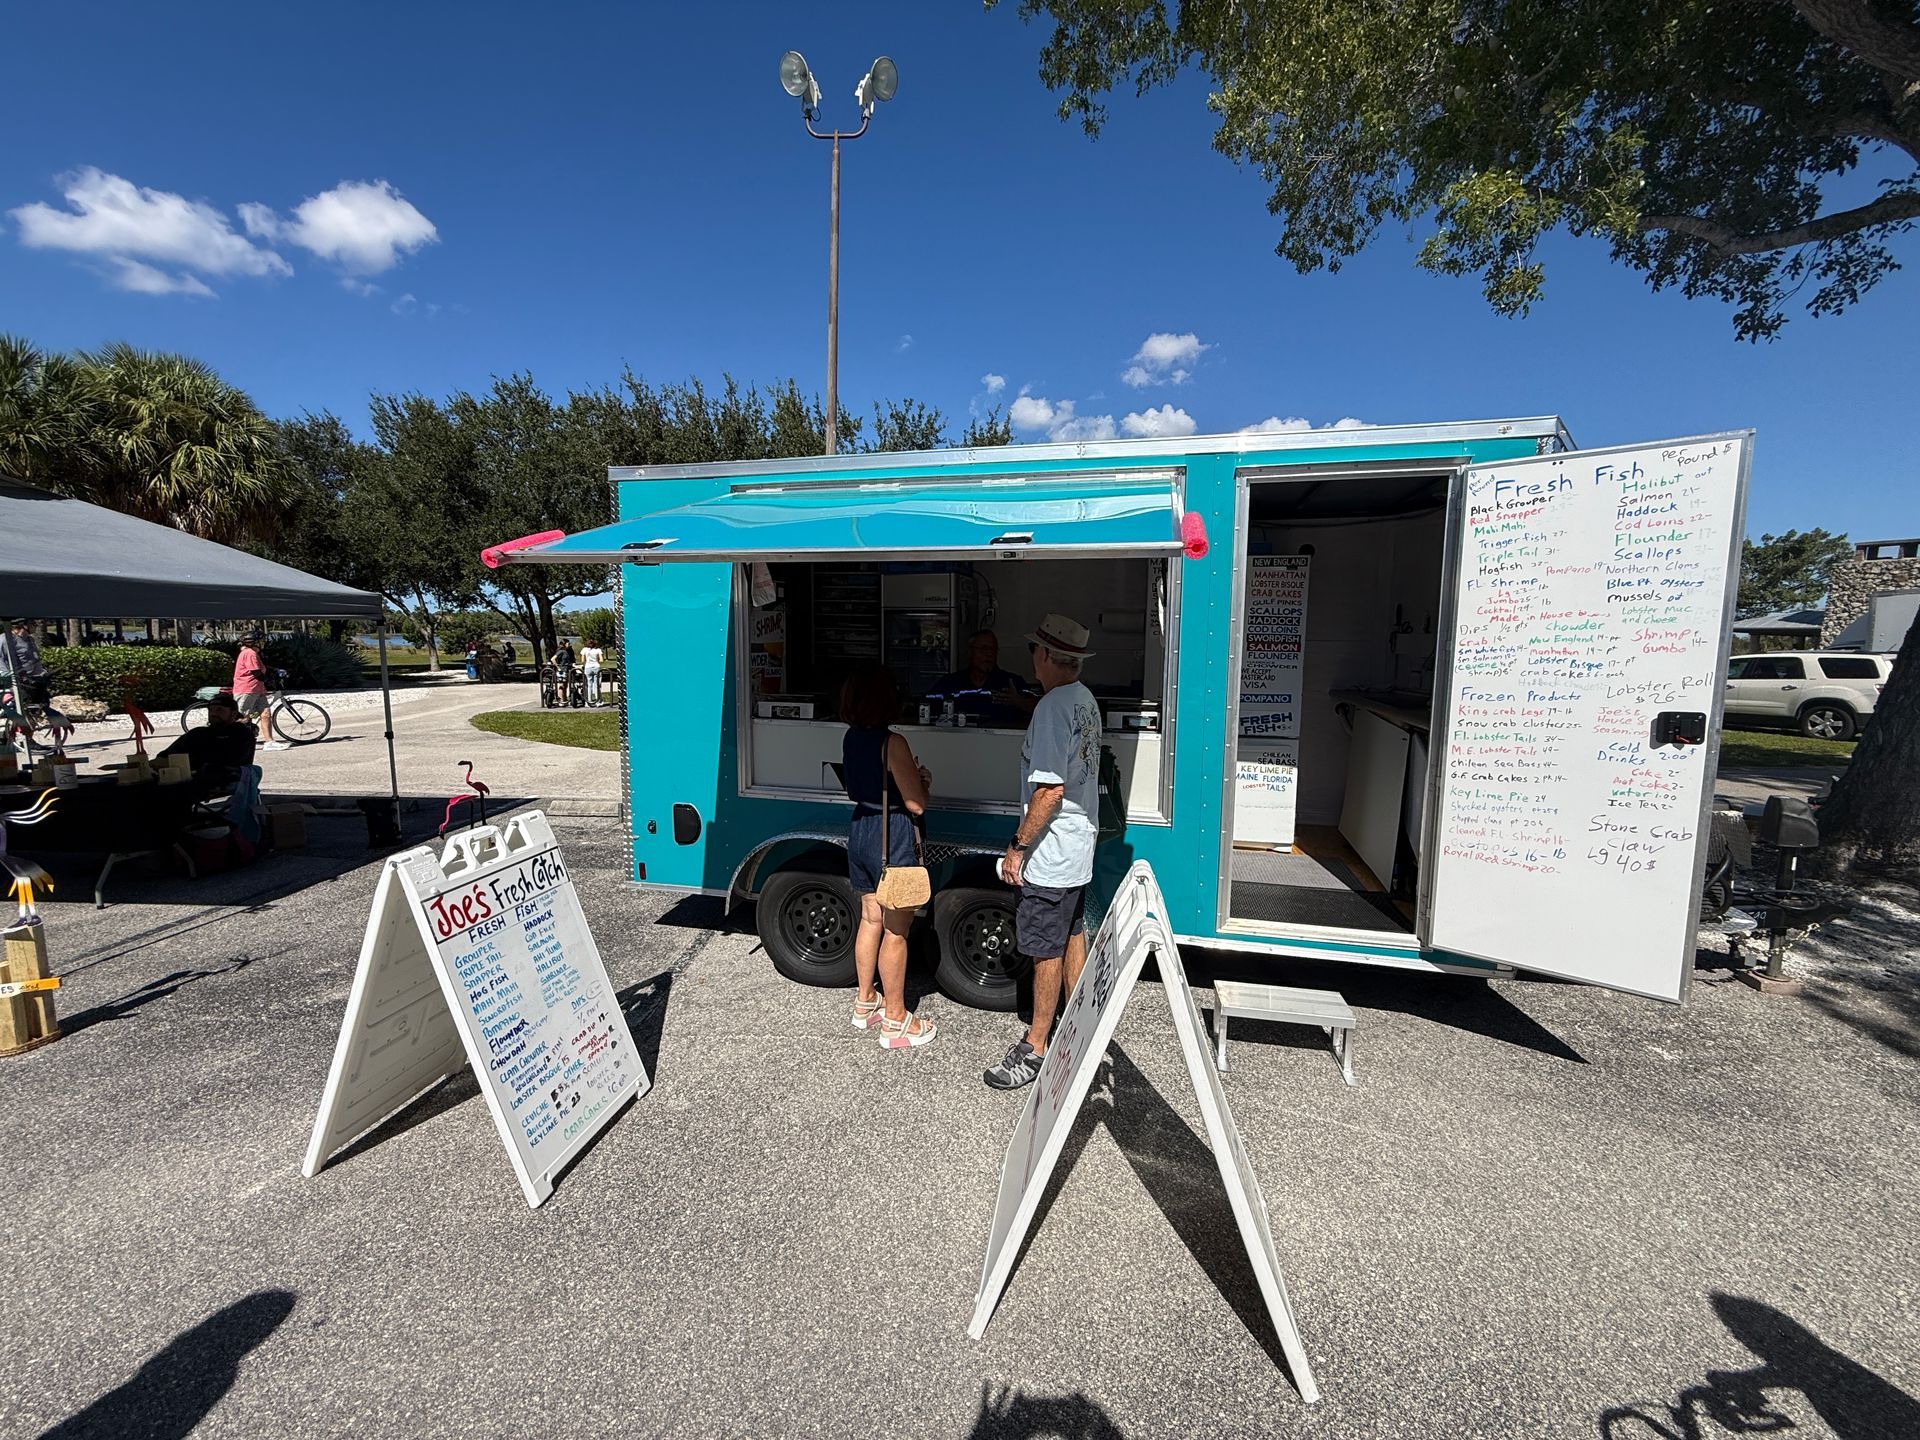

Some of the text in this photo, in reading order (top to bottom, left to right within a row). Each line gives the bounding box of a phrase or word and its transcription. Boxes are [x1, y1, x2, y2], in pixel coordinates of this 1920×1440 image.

[1494, 461, 1643, 500] Fresh Fish
[1622, 473, 1683, 493] Halibut
[1470, 501, 1503, 516] Black
[1505, 495, 1554, 509] Grouper
[1617, 492, 1672, 507] Salmon
[1469, 514, 1489, 526] Red
[1495, 507, 1544, 522] Snapper
[1616, 502, 1677, 519] Haddock
[1614, 519, 1640, 530] Cod
[1615, 529, 1693, 546] Flounder
[1477, 547, 1537, 563] Triple Tail
[1613, 547, 1682, 561] Scallops
[1253, 558, 1307, 567] NEW ENGLAND
[1479, 561, 1522, 576] Hogfish
[1605, 564, 1659, 574] Northern
[1254, 571, 1306, 579] MANHATTAN
[1250, 581, 1305, 590] LOBSTER BISQUE
[1606, 578, 1633, 589] Blue
[1251, 589, 1302, 598] CRAB CAKES
[1606, 589, 1662, 602] mussels
[1486, 596, 1519, 605] Jumbo
[1249, 607, 1303, 616] SCALLOPS
[1488, 610, 1573, 623] Made House
[1621, 605, 1658, 615] Lobster
[1247, 616, 1300, 625] HADDOCK
[1247, 625, 1299, 634] COD LOINS
[1630, 627, 1692, 642] Shrimp
[1247, 634, 1300, 643] SWORDFISH
[1458, 636, 1487, 647] Crab
[1528, 634, 1594, 646] New England
[1248, 643, 1298, 652] SALMON
[1641, 642, 1687, 653] Gumbo
[1247, 652, 1299, 661] FLOUNDER
[1527, 656, 1604, 672] Lobster Bisque
[1251, 667, 1272, 676] ACCEPT
[1243, 681, 1267, 690] VISA
[1605, 679, 1672, 699] Lobster
[1681, 671, 1714, 690] Roll
[1460, 686, 1581, 702] Frozen Products
[1457, 704, 1544, 717] King Legs
[1239, 711, 1293, 726] FRESH
[1243, 723, 1276, 735] FISH
[1592, 724, 1650, 738] Seasoning
[1608, 741, 1641, 753] Cold
[1257, 757, 1296, 766] SEA BASS
[1262, 751, 1291, 759] CHILEAN
[1596, 750, 1647, 765] Drinks
[1240, 765, 1293, 775] KEY LIME PIE
[1493, 759, 1514, 768] Sea
[1262, 775, 1293, 784] FLORIDA
[1496, 773, 1529, 783] Cakes
[1631, 768, 1662, 778] Coke
[1266, 783, 1286, 792] TAILS
[1639, 780, 1672, 791] Coke
[1449, 785, 1529, 802] Key Lime Pie
[1607, 798, 1659, 810] Ice Tea
[1587, 814, 1693, 841] Stone Crab
[1606, 836, 1666, 853] Claw
[1443, 845, 1473, 860] Royal
[1474, 850, 1500, 864] Red
[1501, 857, 1540, 873] Shrimp
[429, 883, 492, 937] Joe's
[488, 867, 534, 909] Fresh
[531, 851, 565, 890] Catch
[523, 909, 554, 932] HADDOCK
[467, 915, 507, 943] FRESH
[527, 933, 555, 952] SALMON
[454, 941, 497, 970] GROUPER
[458, 951, 504, 980] TRIPLE TAIL
[535, 951, 565, 974] HALIBUT
[570, 993, 587, 1011] DIPS
[499, 1063, 519, 1083] CLAM
[519, 1040, 549, 1068] CHOWDER
[562, 1057, 585, 1079] OTHER
[510, 1083, 538, 1111] LOBSTER
[538, 1062, 562, 1086] BISQUE
[521, 1099, 549, 1128] CEVICHE
[559, 1105, 571, 1119] PIE
[526, 1112, 552, 1138] QUICHE
